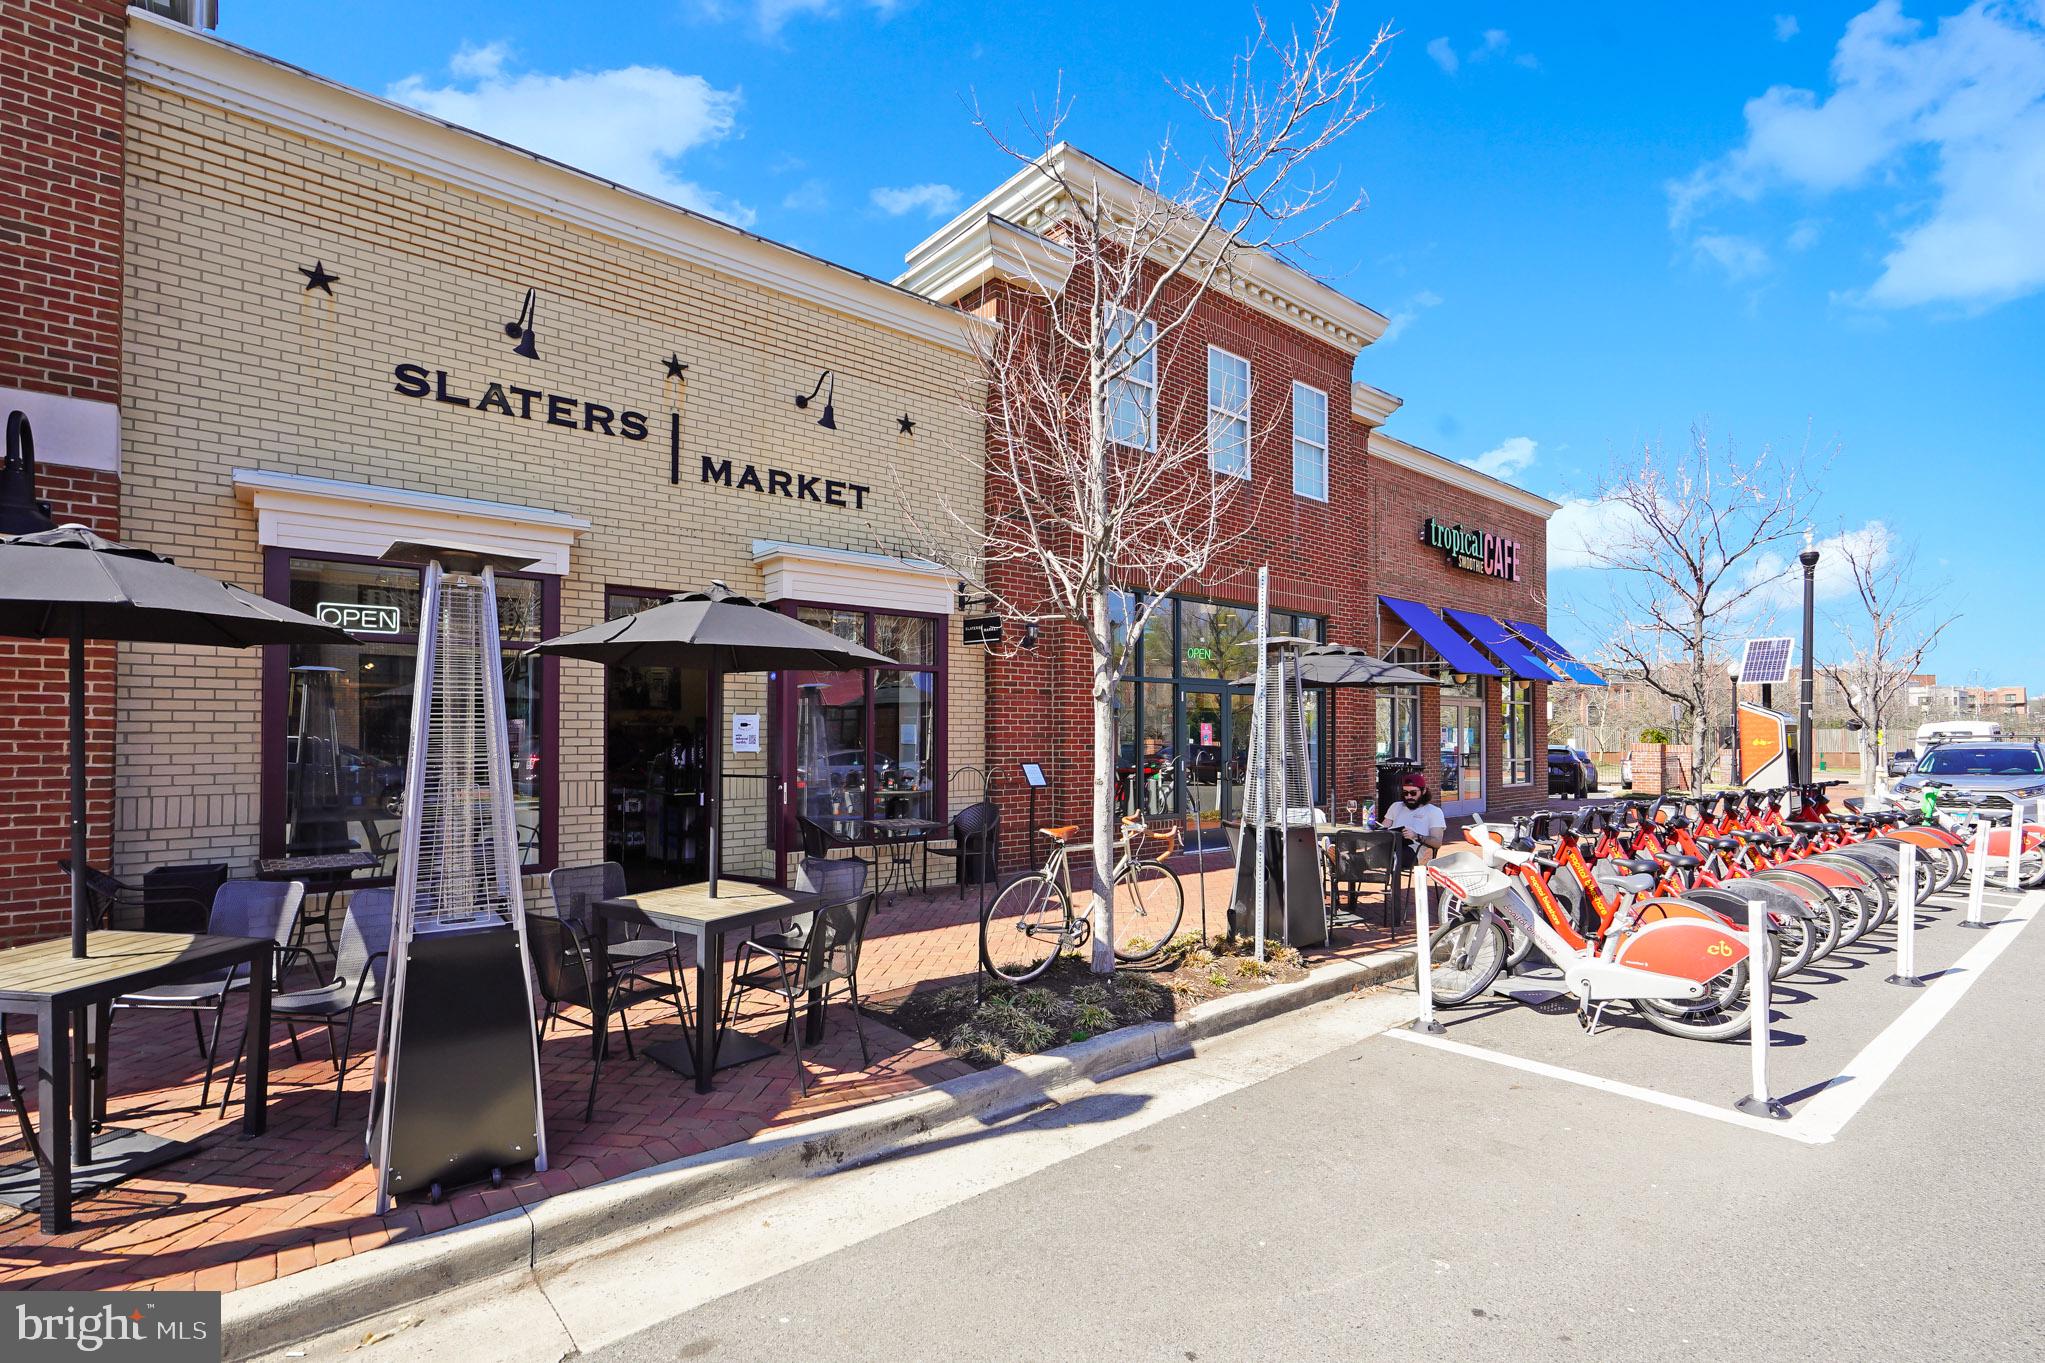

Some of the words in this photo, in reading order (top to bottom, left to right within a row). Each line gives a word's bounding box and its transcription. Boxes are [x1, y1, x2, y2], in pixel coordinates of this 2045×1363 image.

[394, 363, 649, 441] SLATERS
[700, 455, 870, 511] MARKET
[1430, 517, 1484, 559] tropical
[1484, 533, 1521, 582] CAFE
[321, 608, 396, 629] OPEN
[1187, 647, 1211, 660] OPEN
[1530, 875, 1544, 897] capital
[1570, 853, 1587, 880] capital
[1584, 879, 1608, 916] bikeshare
